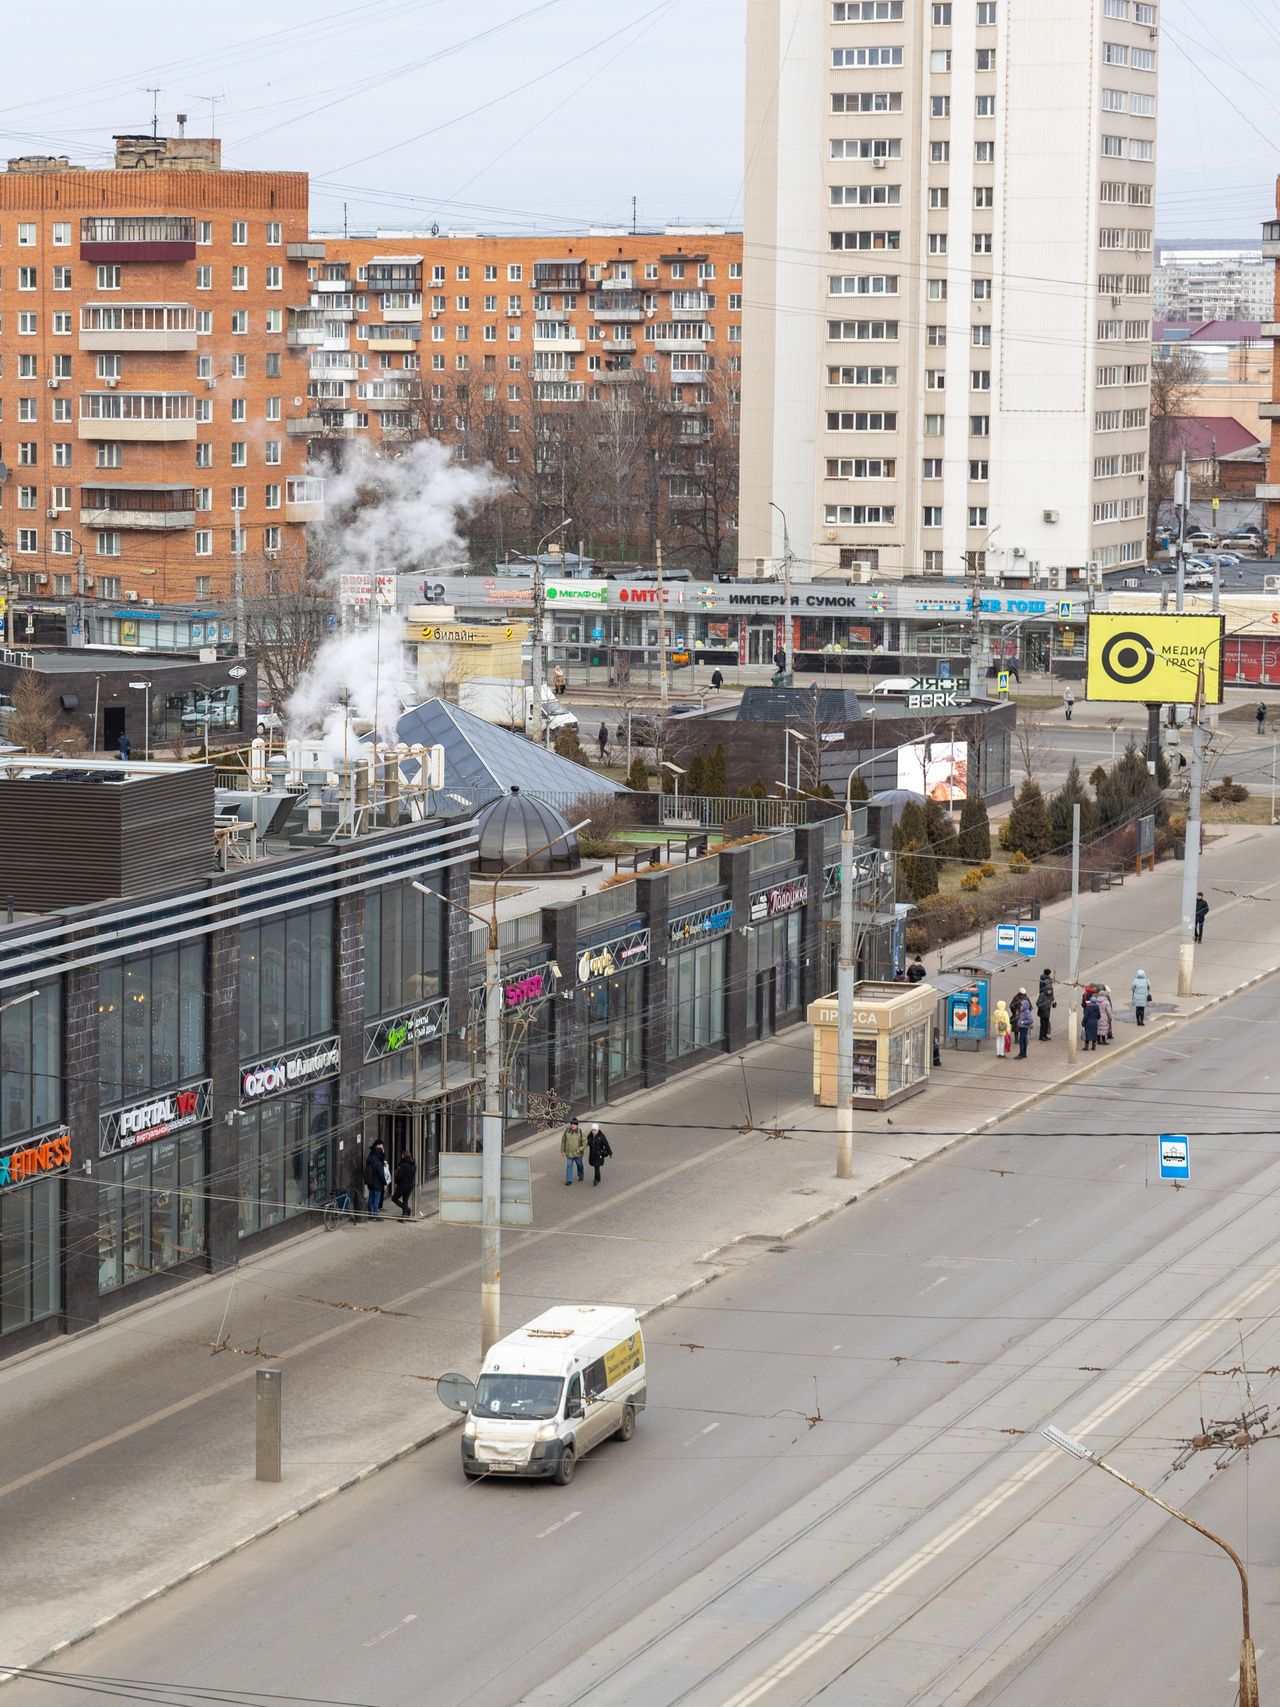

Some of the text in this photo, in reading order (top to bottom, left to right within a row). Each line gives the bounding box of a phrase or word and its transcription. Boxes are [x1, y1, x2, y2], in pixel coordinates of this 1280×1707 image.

[729, 594, 856, 608] ИМПЕРИЯ СУМОК
[1006, 600, 1046, 612] ГОШ
[434, 628, 474, 642] билайн
[1162, 646, 1206, 656] МЕДИА
[1166, 658, 1200, 668] ТРАС
[909, 692, 957, 708] BORK
[770, 884, 808, 916] Подружка
[904, 1000, 923, 1017] ПРЕССА
[244, 1064, 286, 1097] OZON
[120, 1091, 197, 1136] PORTAL VR
[10, 1136, 72, 1181] FITNESS
[494, 1364, 500, 1372] 9
[490, 1400, 500, 1412] 9
